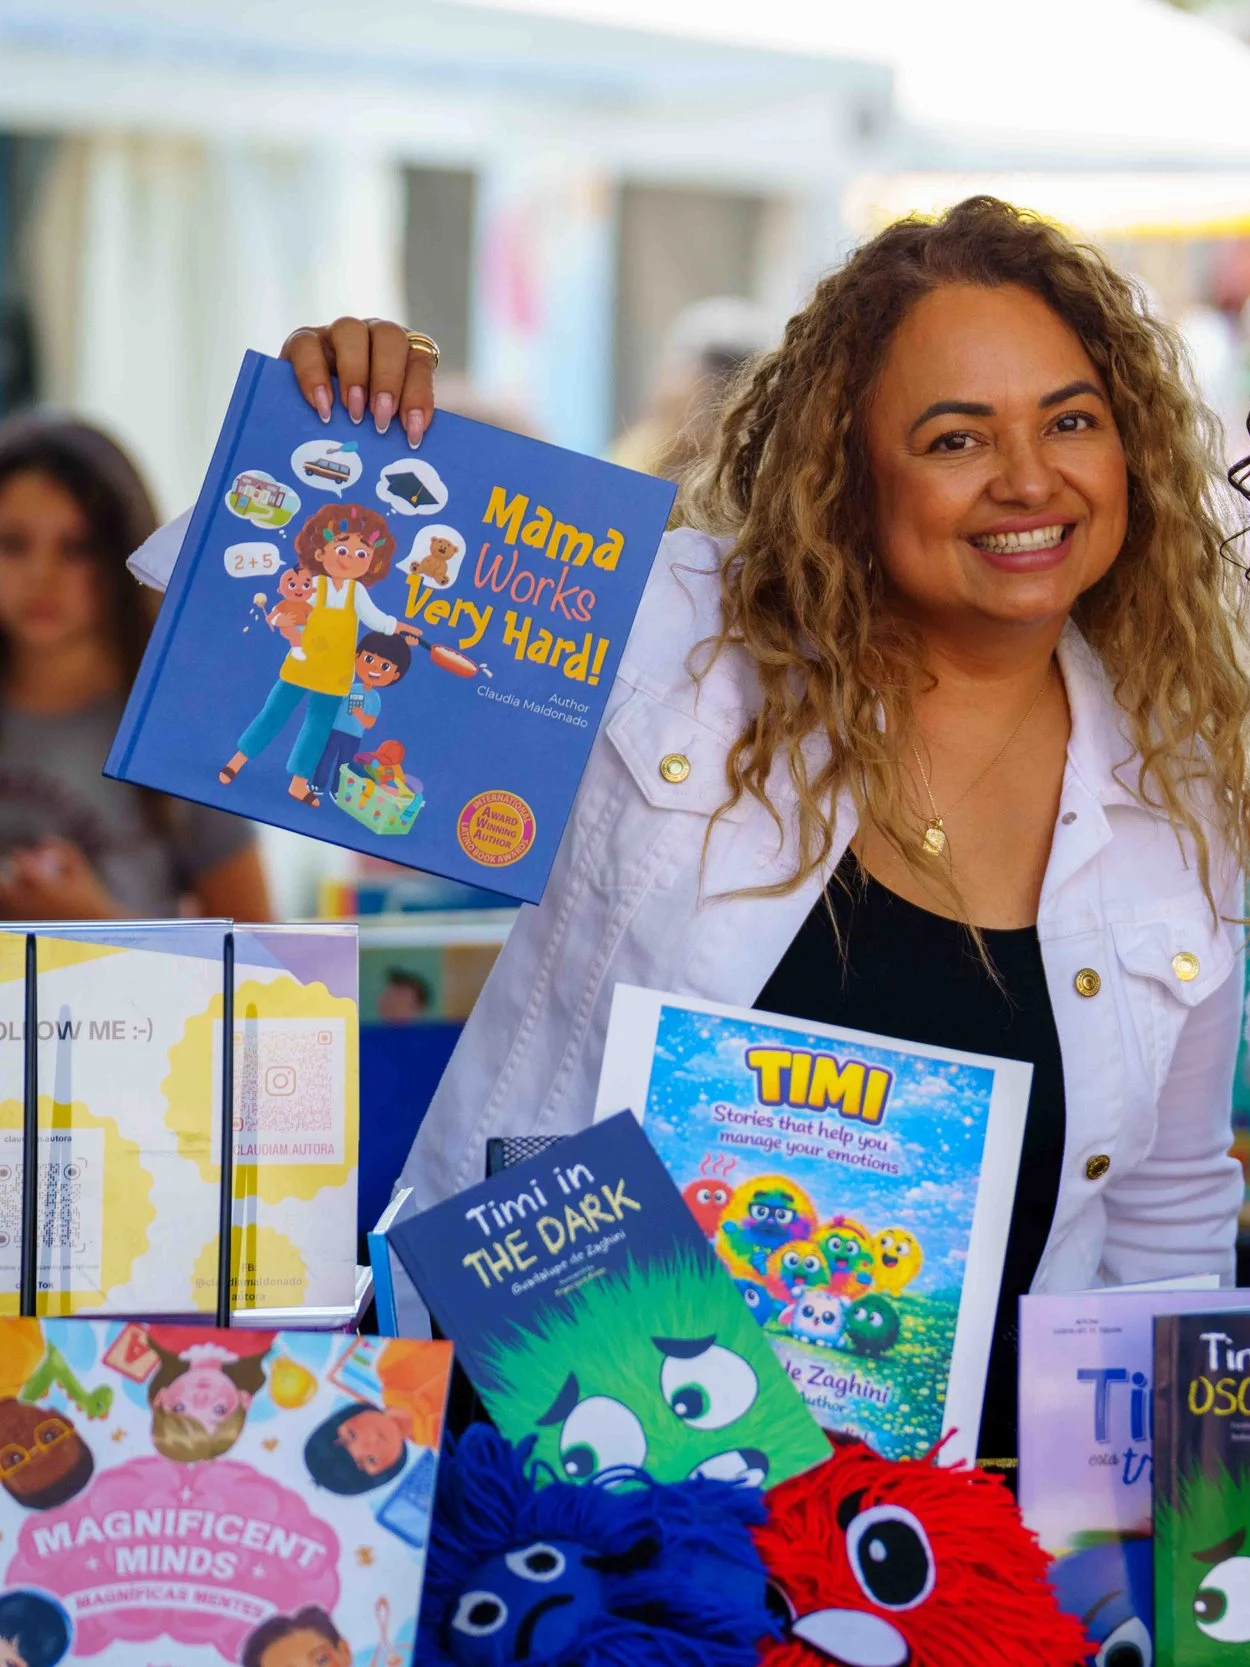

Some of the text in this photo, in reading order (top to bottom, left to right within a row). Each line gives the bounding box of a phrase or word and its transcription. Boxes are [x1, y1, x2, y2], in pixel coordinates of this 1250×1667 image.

[482, 485, 625, 572] Mama
[234, 555, 245, 570] 2
[262, 553, 273, 568] 5
[474, 542, 596, 622] Works
[405, 571, 610, 686] Very Hard!
[476, 685, 589, 728] Claudia Maldonado
[548, 693, 591, 713] Author
[472, 793, 531, 824] INTERNATIONAL
[472, 848, 497, 864] BOOK
[497, 839, 530, 864] AWARDS
[89, 1020, 126, 1041] ME
[132, 1017, 153, 1042] :-)
[745, 1045, 894, 1126] TIMI
[714, 1103, 888, 1152] Stories that help you
[719, 1130, 899, 1175] manage your emotions
[465, 1163, 595, 1236] Timi in
[462, 1228, 538, 1289] THE
[536, 1177, 641, 1255] DARK
[807, 1364, 891, 1404] Zaghini
[32, 1508, 327, 1568] MAGNIFICENT
[115, 1546, 240, 1580] MINDS
